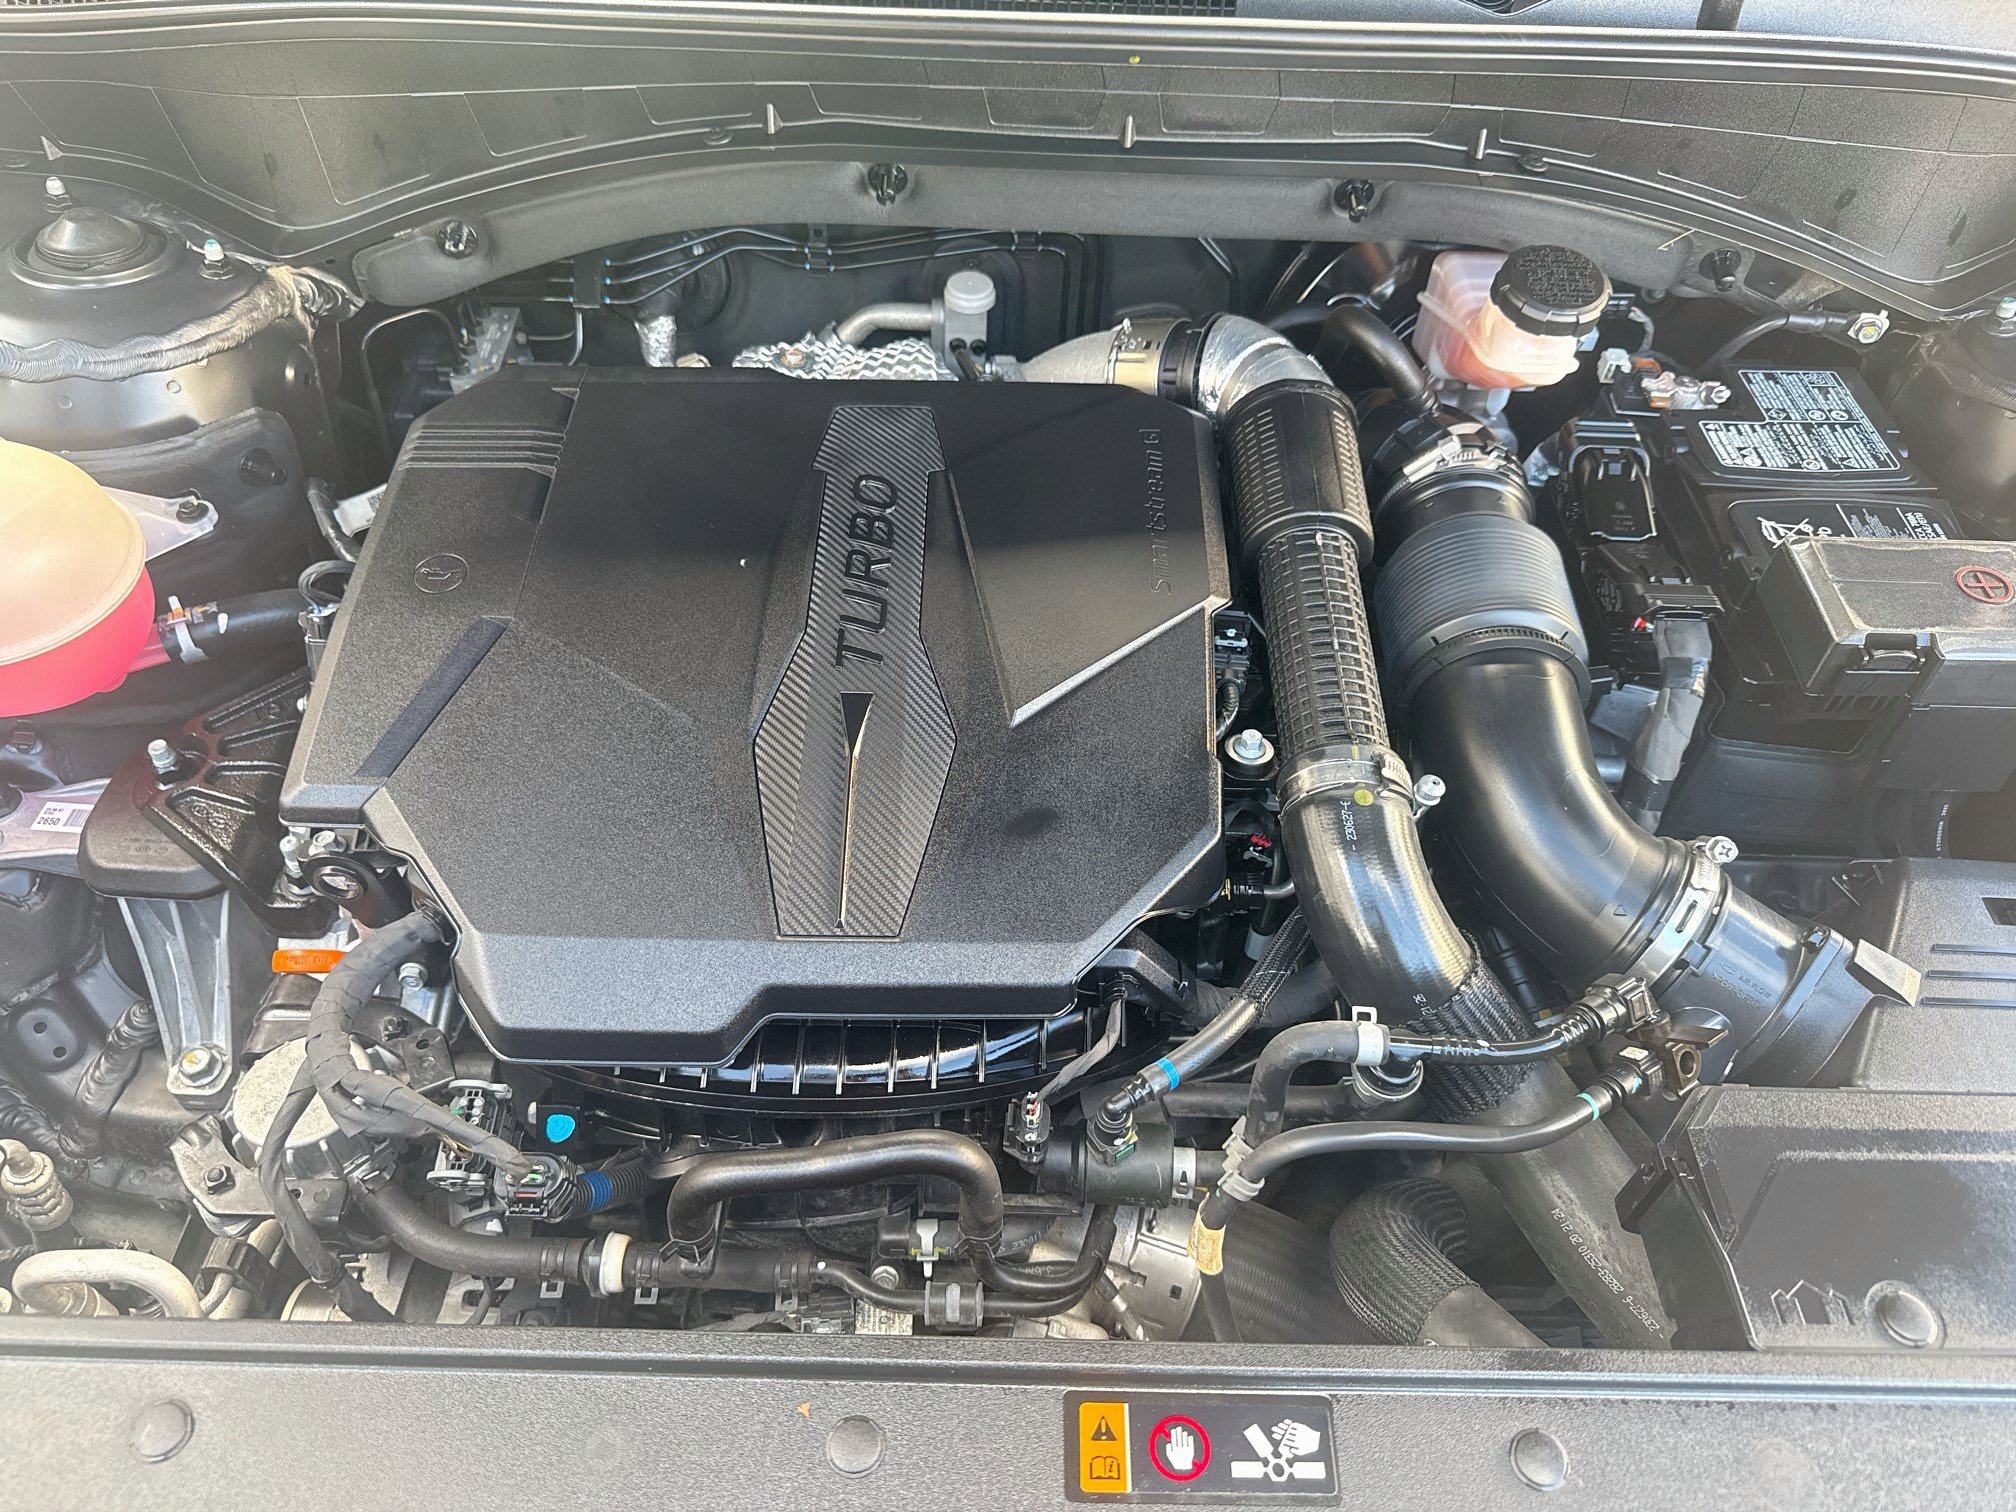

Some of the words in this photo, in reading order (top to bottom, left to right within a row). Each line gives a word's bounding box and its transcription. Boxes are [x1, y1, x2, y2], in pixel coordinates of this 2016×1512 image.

[1146, 449, 1172, 597] Smartstream
[834, 474, 899, 671] TURBO
[37, 817, 61, 826] 2650
[1550, 1208, 1583, 1246] 20:21:24
[1622, 1295, 1660, 1332] 230627-6
